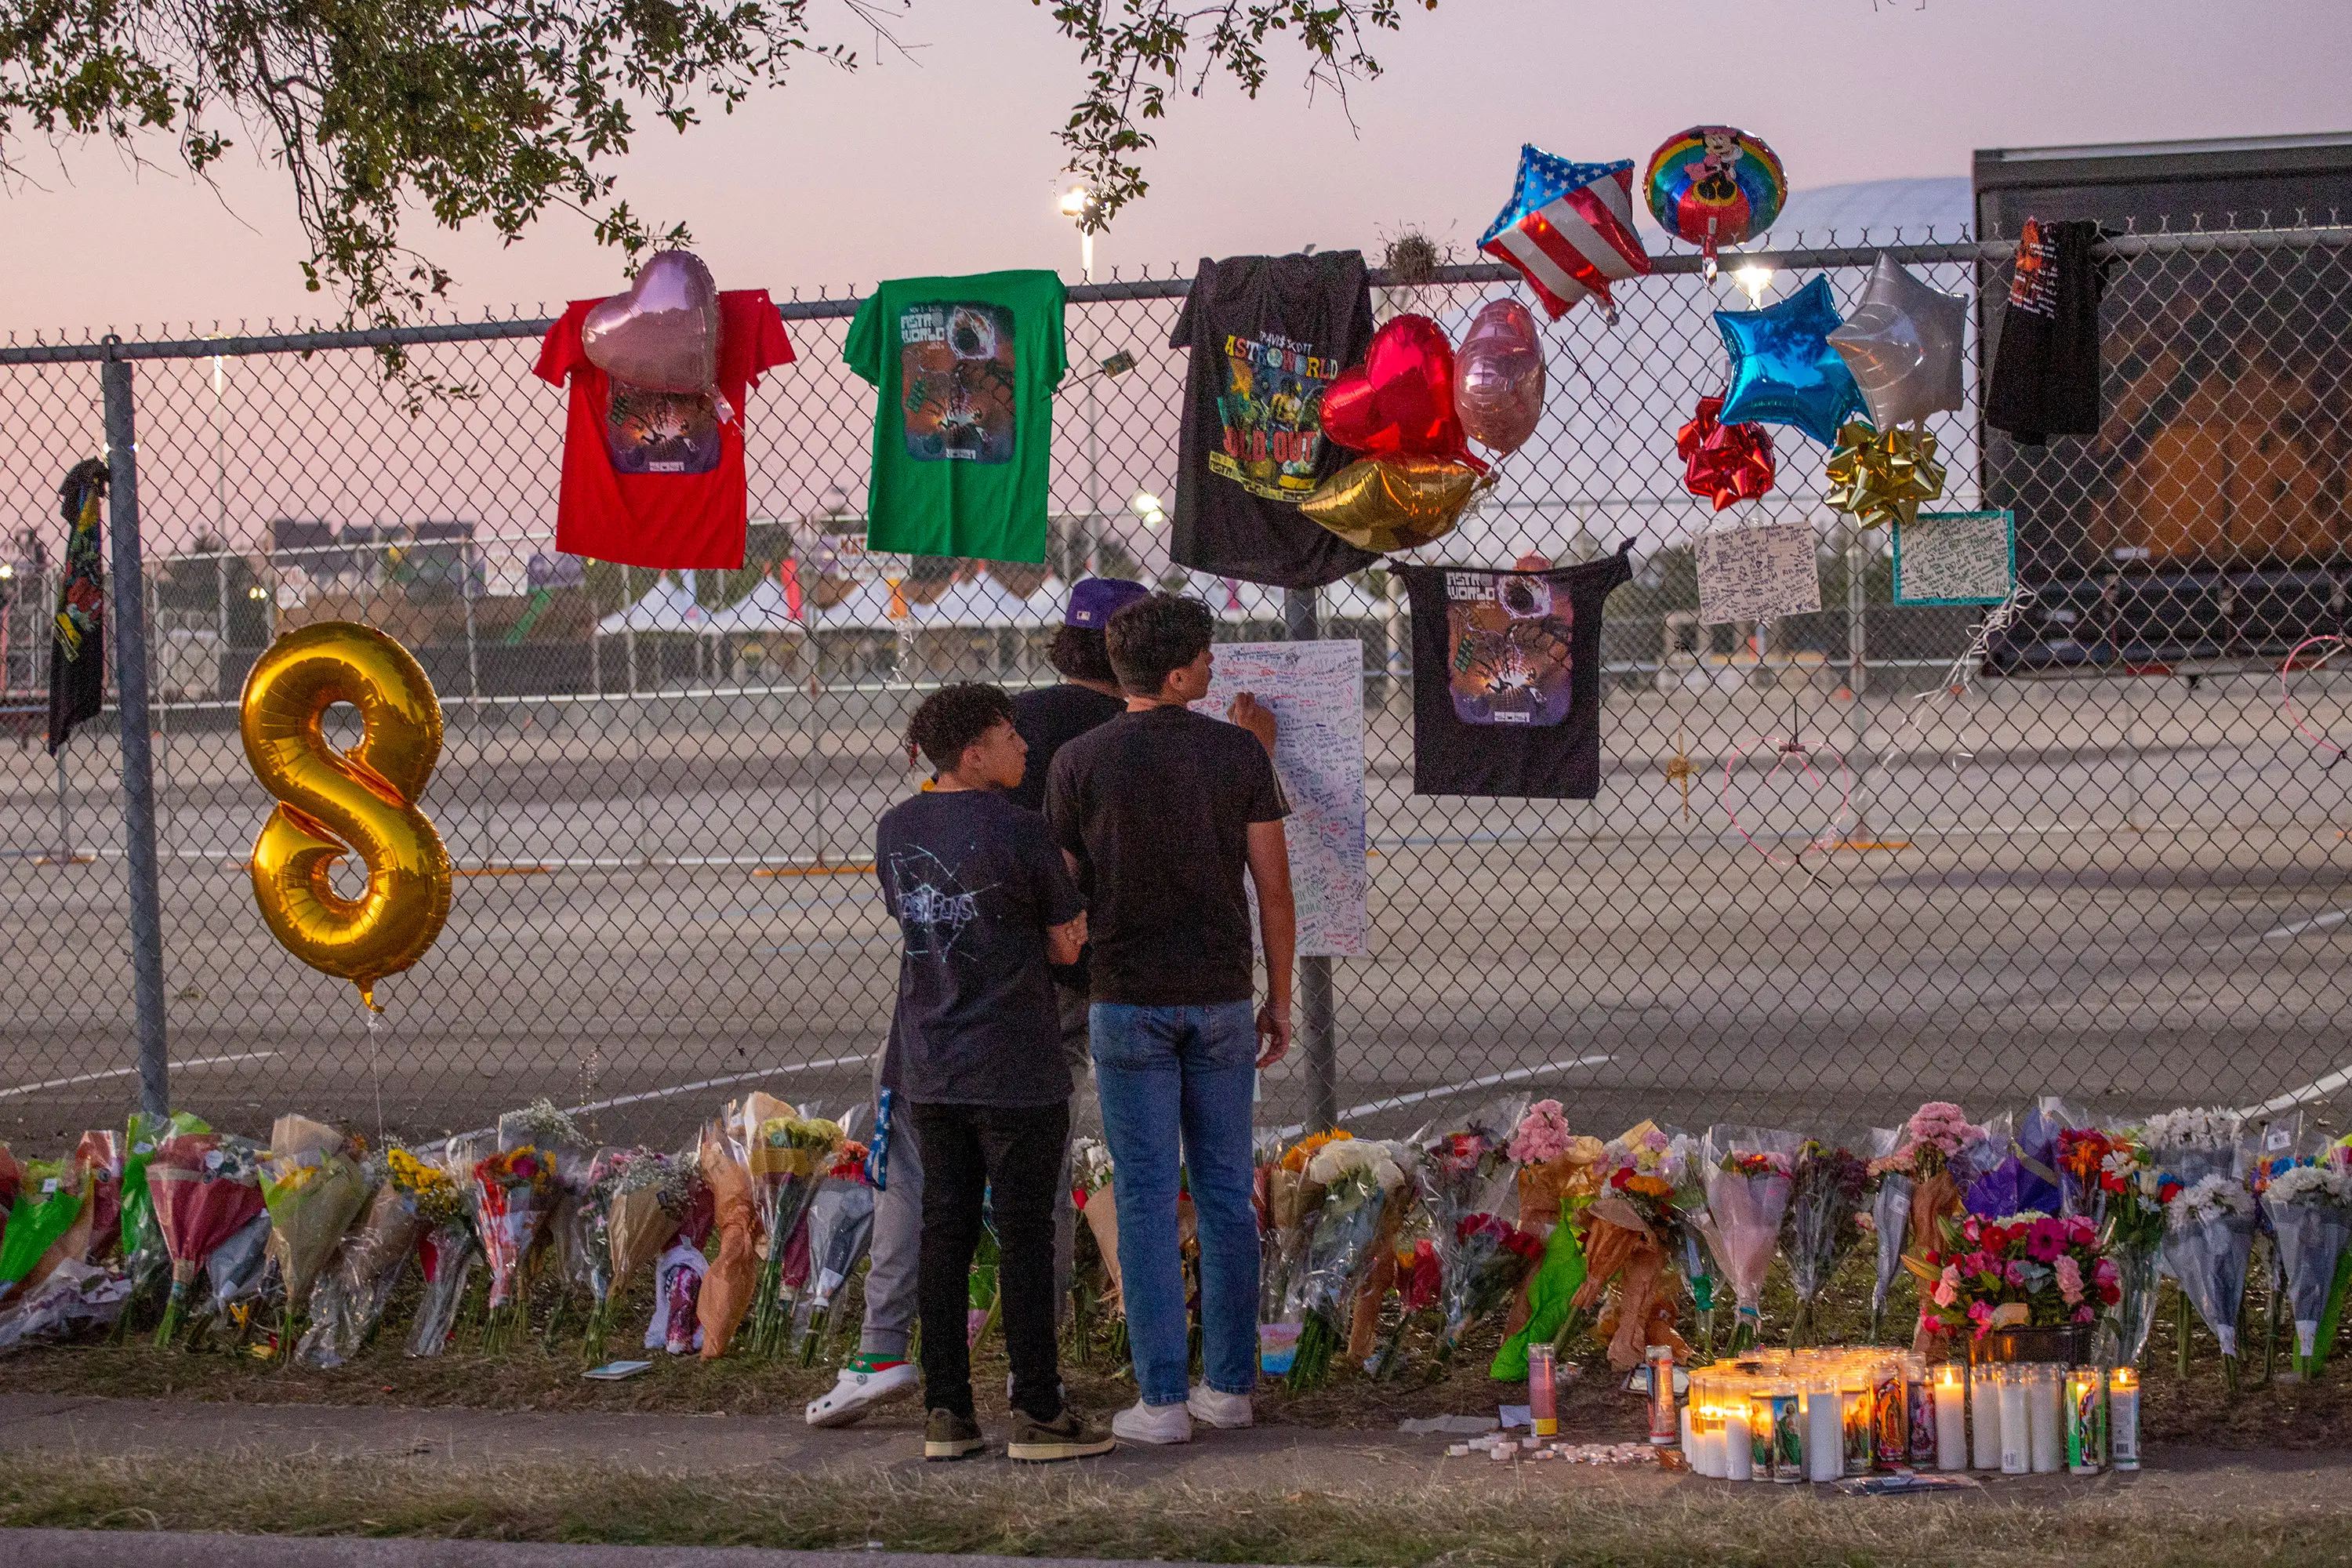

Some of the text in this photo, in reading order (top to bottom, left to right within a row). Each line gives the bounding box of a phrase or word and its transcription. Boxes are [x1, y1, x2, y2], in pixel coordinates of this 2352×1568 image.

[902, 327, 946, 343] WORLD
[1225, 335, 1339, 380] ASTROWORLD
[1273, 431, 1317, 464] OUT
[1446, 572, 1493, 586] ASTRO
[1446, 586, 1495, 601] WORLD
